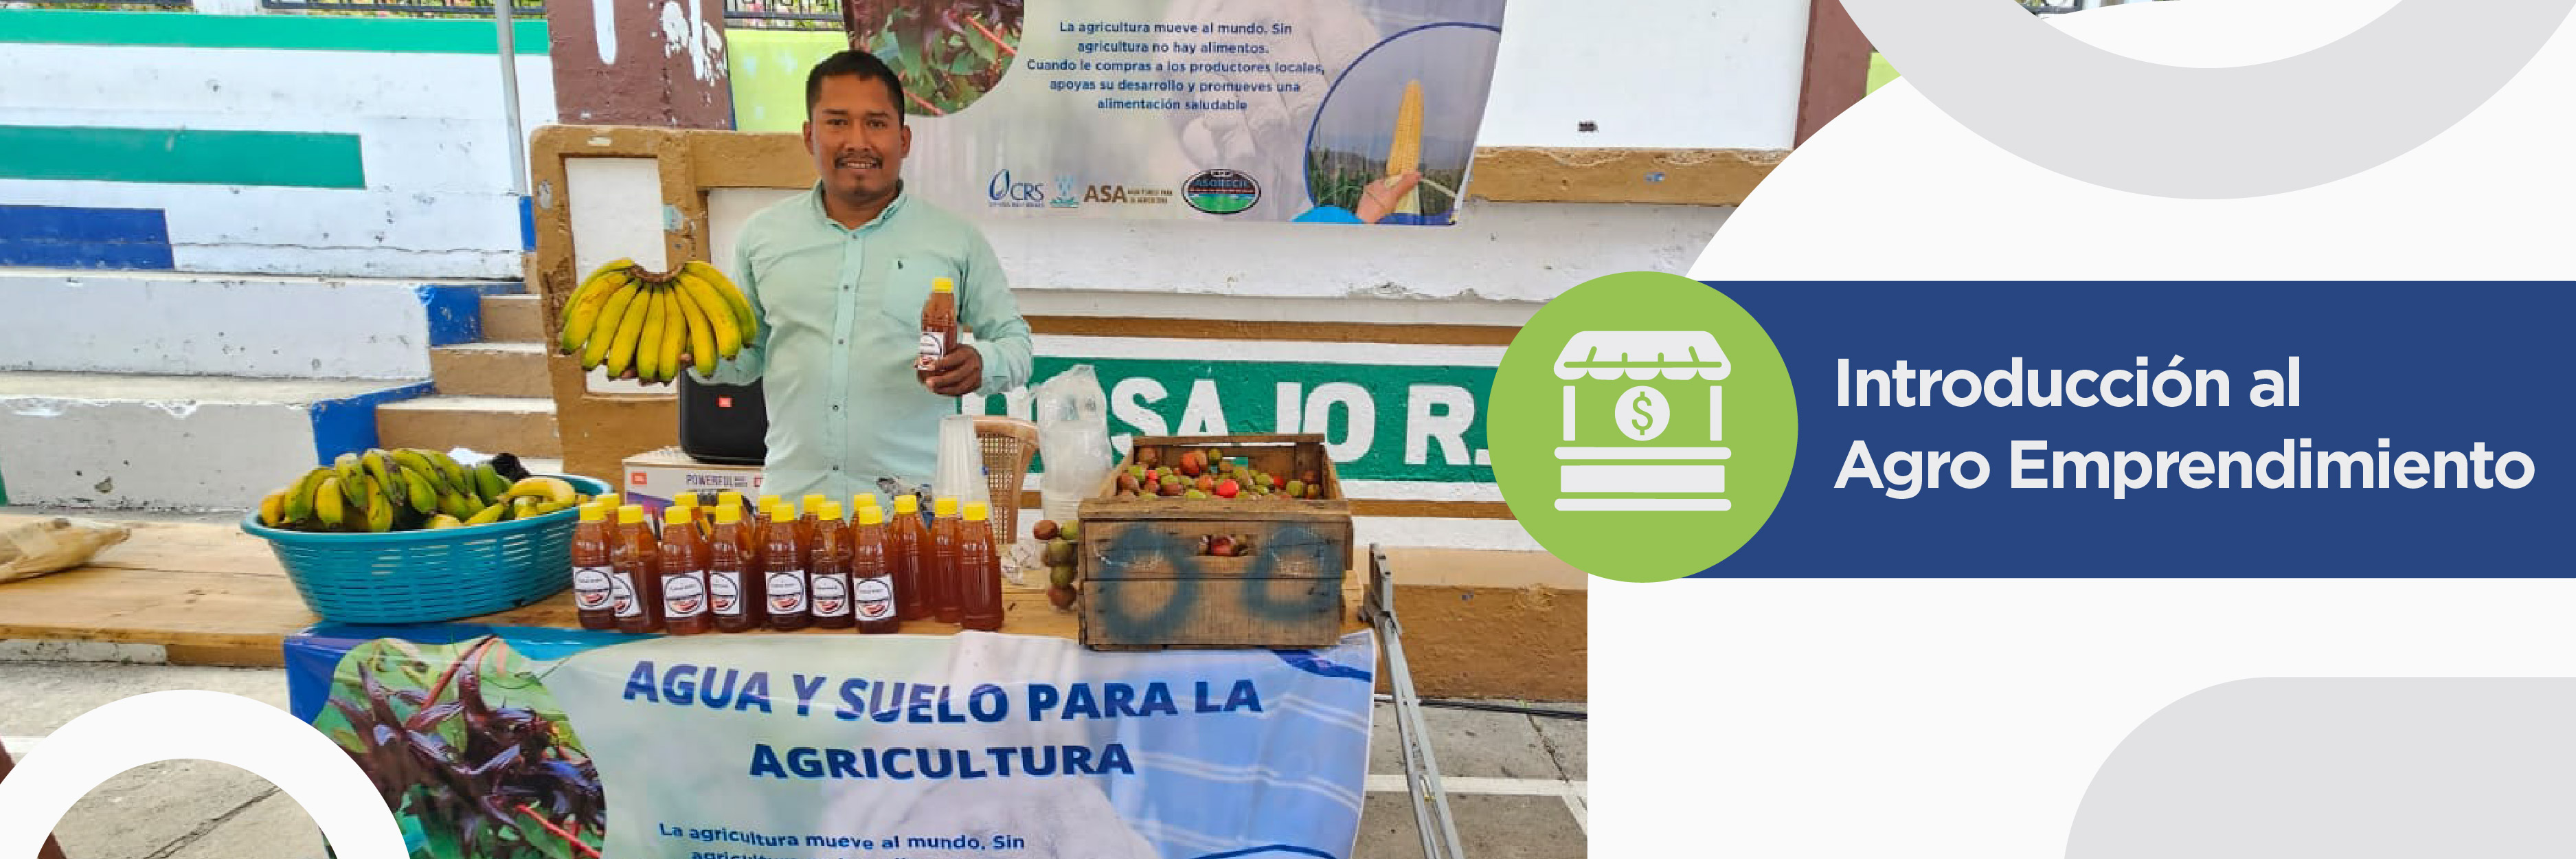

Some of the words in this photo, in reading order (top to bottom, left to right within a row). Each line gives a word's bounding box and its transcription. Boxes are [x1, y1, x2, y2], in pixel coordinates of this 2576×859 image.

[1060, 22, 1075, 32] La
[1078, 22, 1150, 35] agricultura
[1154, 23, 1199, 33] mueve
[1201, 22, 1213, 33] al
[1218, 23, 1268, 34] mundo.
[1272, 23, 1292, 35] Sin
[1077, 41, 1149, 54] agricultura
[1152, 43, 1169, 53] no
[1173, 41, 1196, 54] hay
[1201, 41, 1269, 54] alimentos.
[1027, 58, 1077, 71] Cuando
[1080, 59, 1092, 71] le
[1096, 61, 1151, 74] compras
[1155, 62, 1163, 71] a
[1168, 60, 1186, 72] los
[1190, 60, 1271, 74] productores
[1274, 61, 1324, 76] locales,
[1050, 80, 1096, 91] apoyas
[1099, 80, 1114, 91] su
[1118, 79, 1184, 91] desarrollo
[1188, 82, 1196, 93] y
[1199, 82, 1272, 92] promueves
[1276, 83, 1300, 93] una
[1098, 98, 1180, 109] alimentación
[1184, 99, 1247, 111] saludable
[1010, 182, 1045, 201] CRS
[1083, 184, 1127, 204] ASA
[622, 660, 773, 714] AGUA
[792, 674, 826, 717] Y
[835, 678, 1009, 724] SUELO
[1028, 682, 1178, 722] PARA
[1195, 679, 1263, 713] LA
[749, 744, 1135, 780] AGRICULTURA
[659, 822, 683, 837] La
[689, 827, 798, 847] agricultura
[806, 835, 874, 850] mueve
[882, 834, 900, 849] al
[907, 834, 986, 850] mundo.
[992, 834, 1025, 849] Sin
